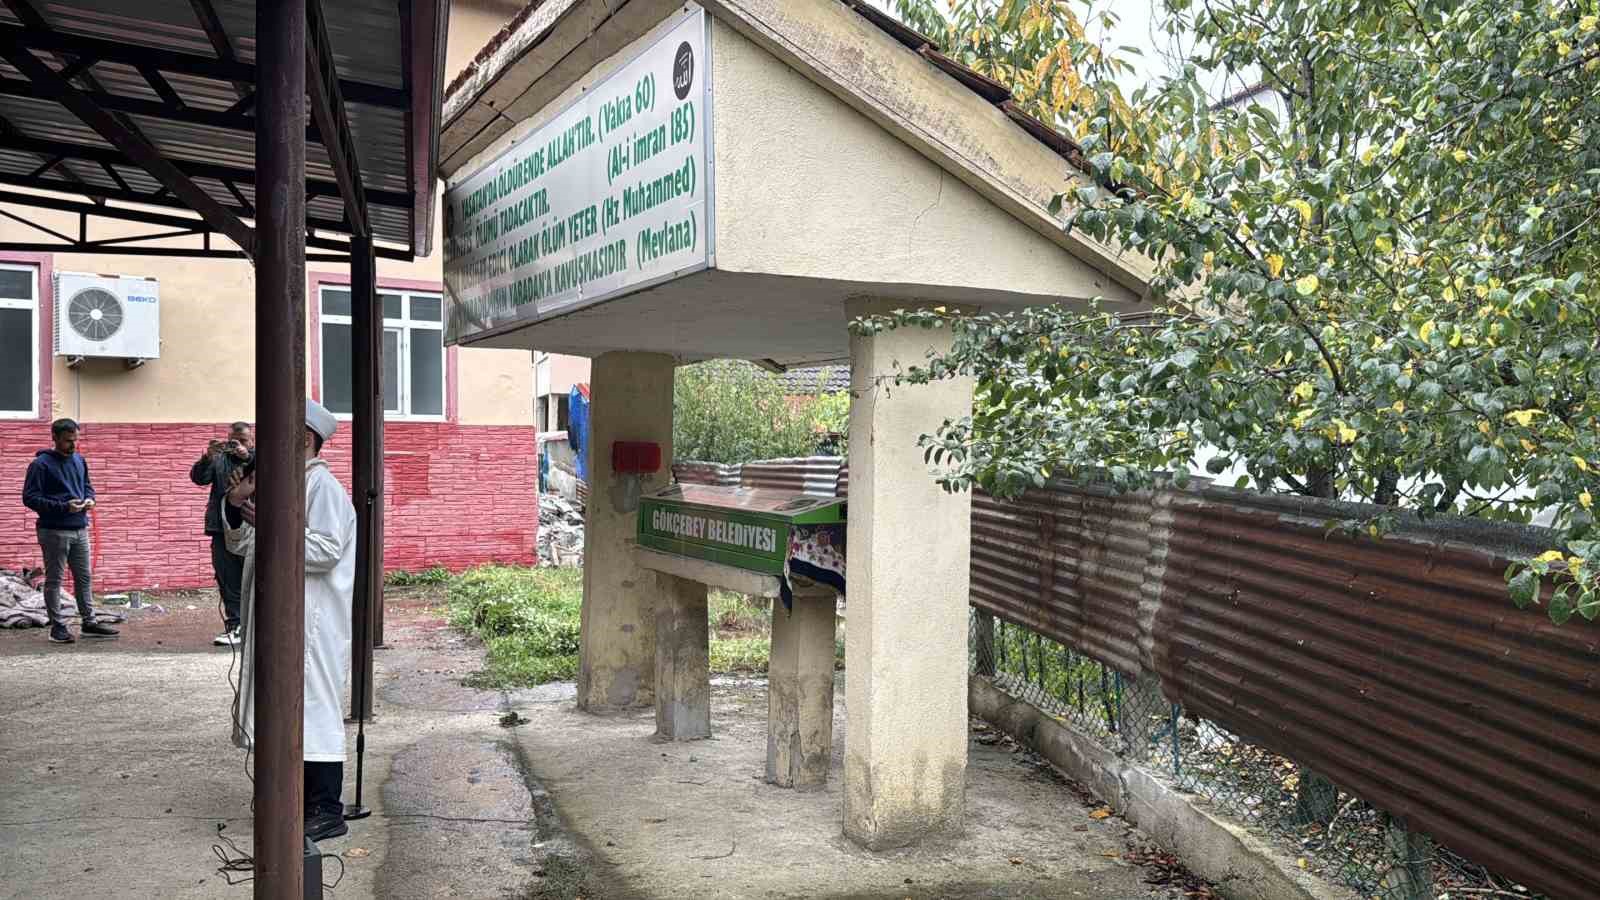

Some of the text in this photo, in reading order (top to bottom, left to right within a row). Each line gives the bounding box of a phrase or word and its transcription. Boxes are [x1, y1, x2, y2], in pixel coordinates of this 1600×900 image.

[497, 147, 545, 199] ÖLDÜRENDE
[546, 116, 596, 171] ALLAH'TIR.
[635, 72, 656, 115] 60)
[500, 187, 550, 236] TADACAKTIR.
[670, 101, 695, 146] 185)
[508, 232, 540, 268] OLARAK
[541, 214, 567, 253] ÖLÜM
[568, 204, 598, 243] YETER
[601, 196, 620, 236] (Hz
[623, 155, 696, 220] Muhammed)
[554, 239, 627, 292] KAVUŞMASIDIR
[636, 210, 697, 271] (Mevlana)
[652, 507, 706, 538] GÖKÇEBEY
